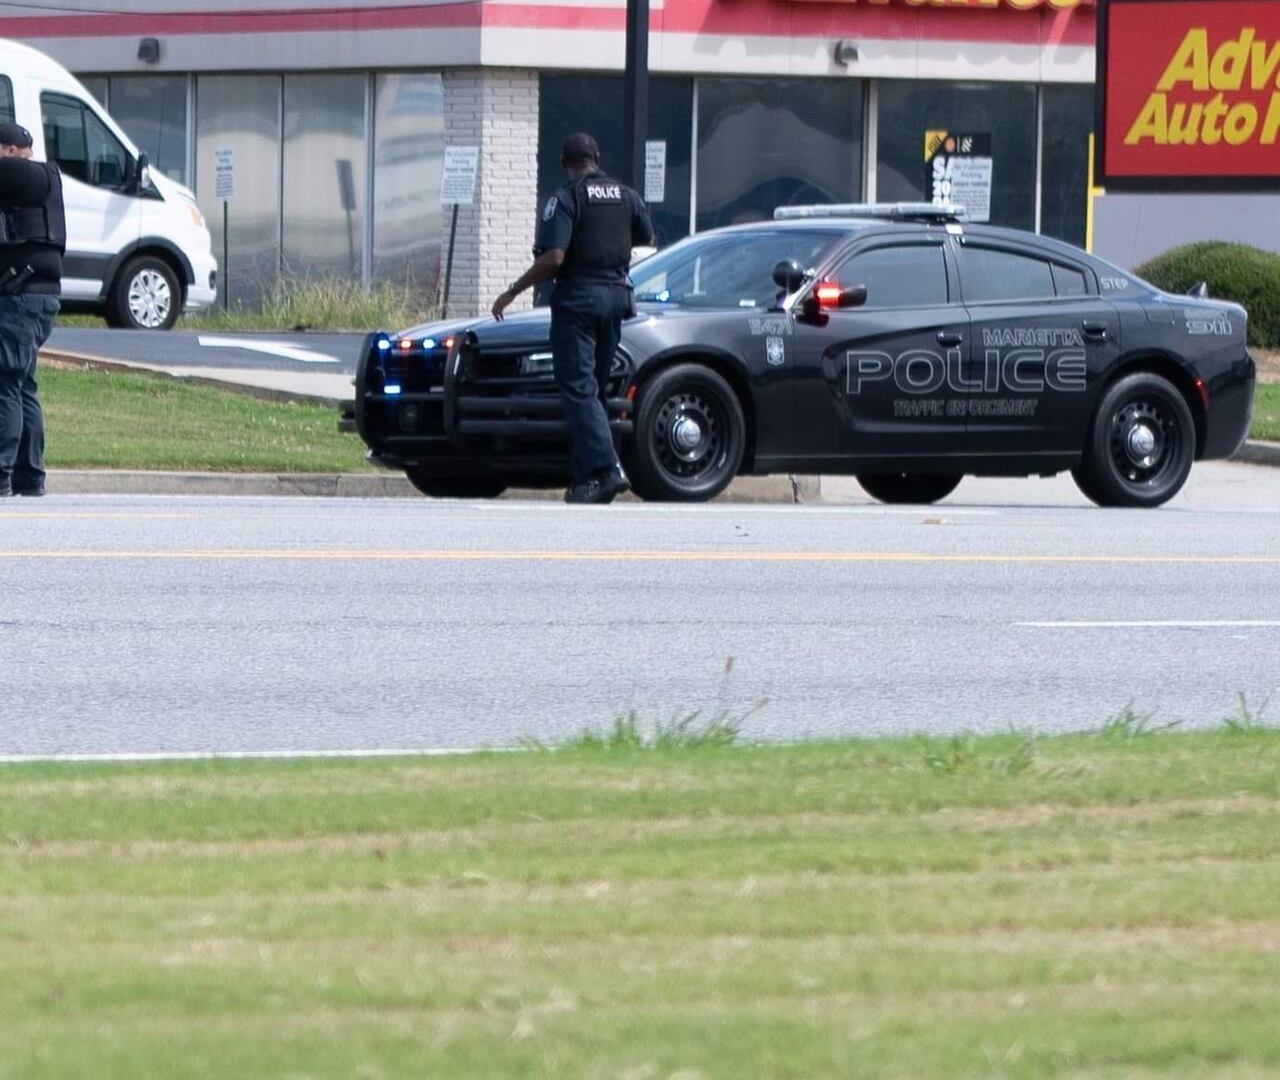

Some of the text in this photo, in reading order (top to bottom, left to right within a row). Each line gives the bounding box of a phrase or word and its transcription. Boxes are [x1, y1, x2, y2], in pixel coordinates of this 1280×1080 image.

[1155, 27, 1280, 91] Adv
[1123, 92, 1258, 145] Auto
[586, 185, 621, 199] POLICE
[983, 327, 1086, 347] MARIETTA
[846, 349, 1088, 395] POLICE
